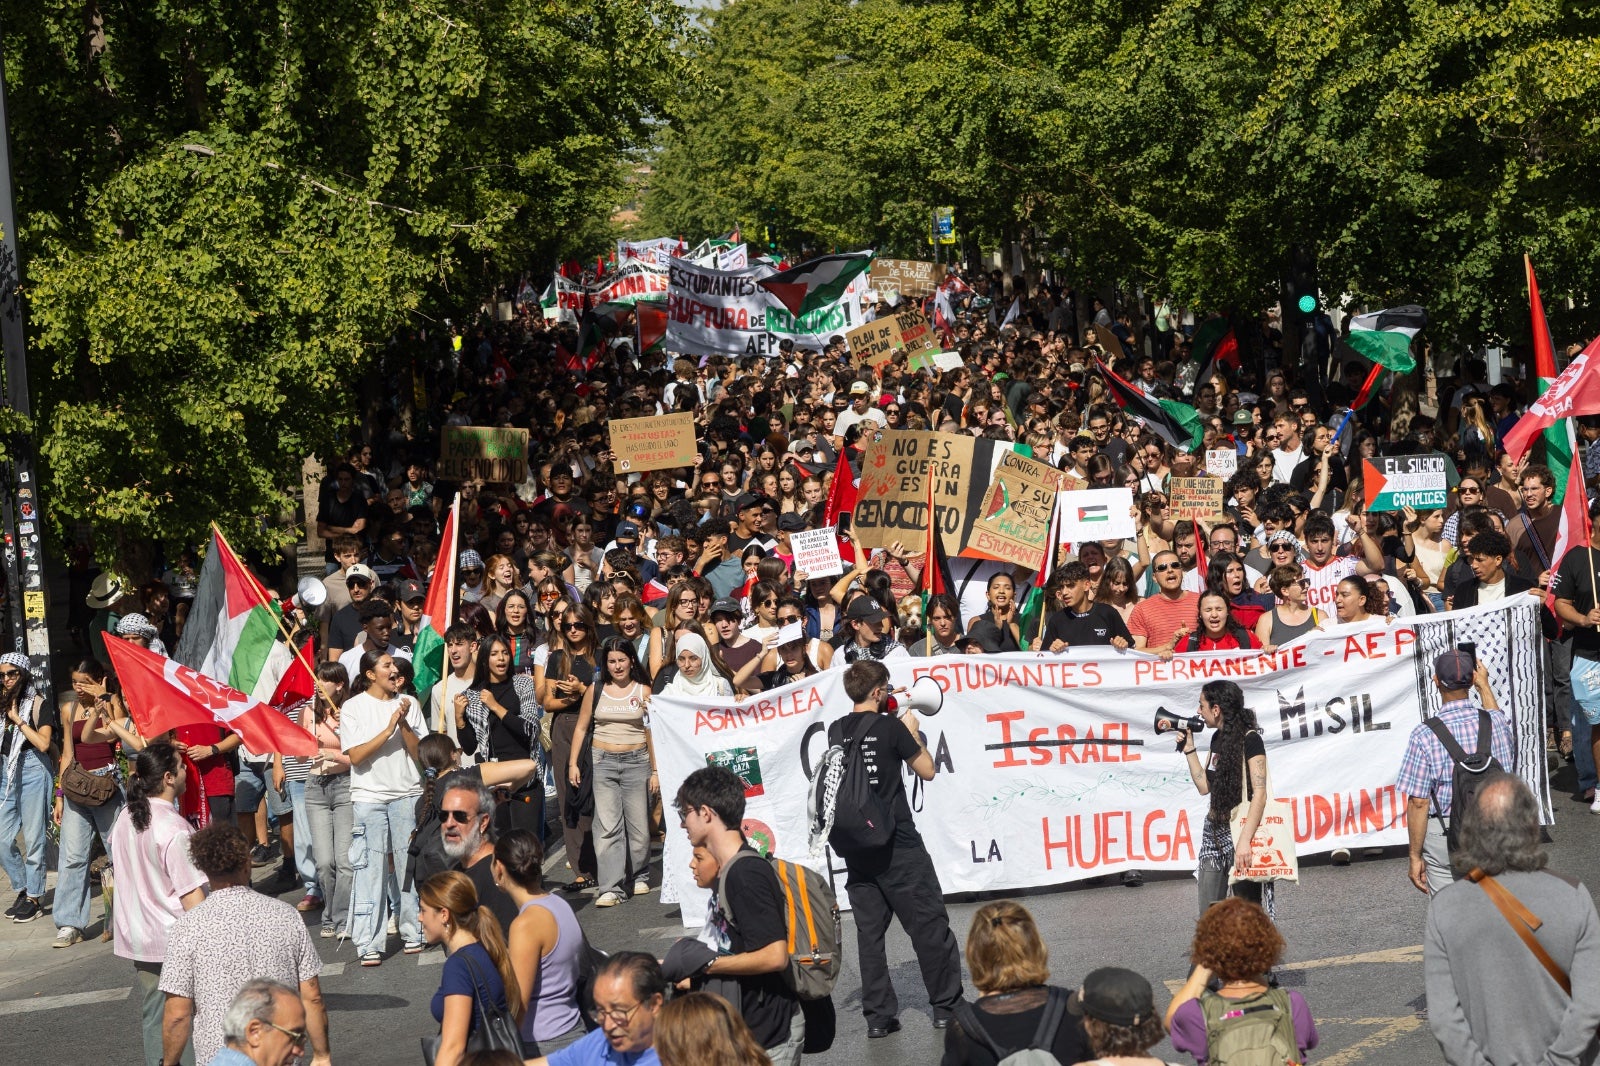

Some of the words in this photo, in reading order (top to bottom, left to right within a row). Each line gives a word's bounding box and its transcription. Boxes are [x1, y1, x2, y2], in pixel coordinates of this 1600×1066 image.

[877, 260, 895, 268] POR
[899, 261, 912, 270] EL
[889, 269, 900, 277] DE
[904, 270, 930, 279] ISRAEL
[670, 265, 755, 297] ESTUDIANTES
[668, 293, 749, 330] RUPTURA
[750, 315, 765, 328] DE
[746, 333, 778, 354] AEP
[852, 330, 875, 350] PLAN
[879, 327, 891, 338] DE
[871, 339, 890, 355] PLAN
[628, 430, 676, 440] INJUSTAS
[634, 450, 676, 461] OPRESOR
[892, 438, 918, 456] NO
[927, 438, 952, 459] ES
[461, 457, 524, 482] GENOCIDIO
[896, 459, 961, 480] GUERRA
[1004, 454, 1039, 478] CONTRA
[1385, 458, 1403, 474] EL
[1407, 457, 1444, 474] SILENCIO
[900, 477, 921, 492] ES
[1021, 482, 1029, 494] Y
[1033, 489, 1052, 505] SU
[1392, 491, 1447, 506] COMPLICES
[854, 499, 961, 535] GENOCIDIO
[1179, 507, 1211, 517] MATAN
[998, 519, 1045, 544] HUELGA
[976, 532, 1043, 566] ESTUDIANTI
[694, 686, 824, 736] ASAMBLEA
[913, 662, 1103, 694] ESTUDIANTES
[1135, 644, 1308, 686] PERMANENTE
[1343, 628, 1416, 663] AEP
[986, 710, 1143, 769] ISRAEL
[971, 838, 1002, 863] LA
[1042, 809, 1196, 869] HUELGA
